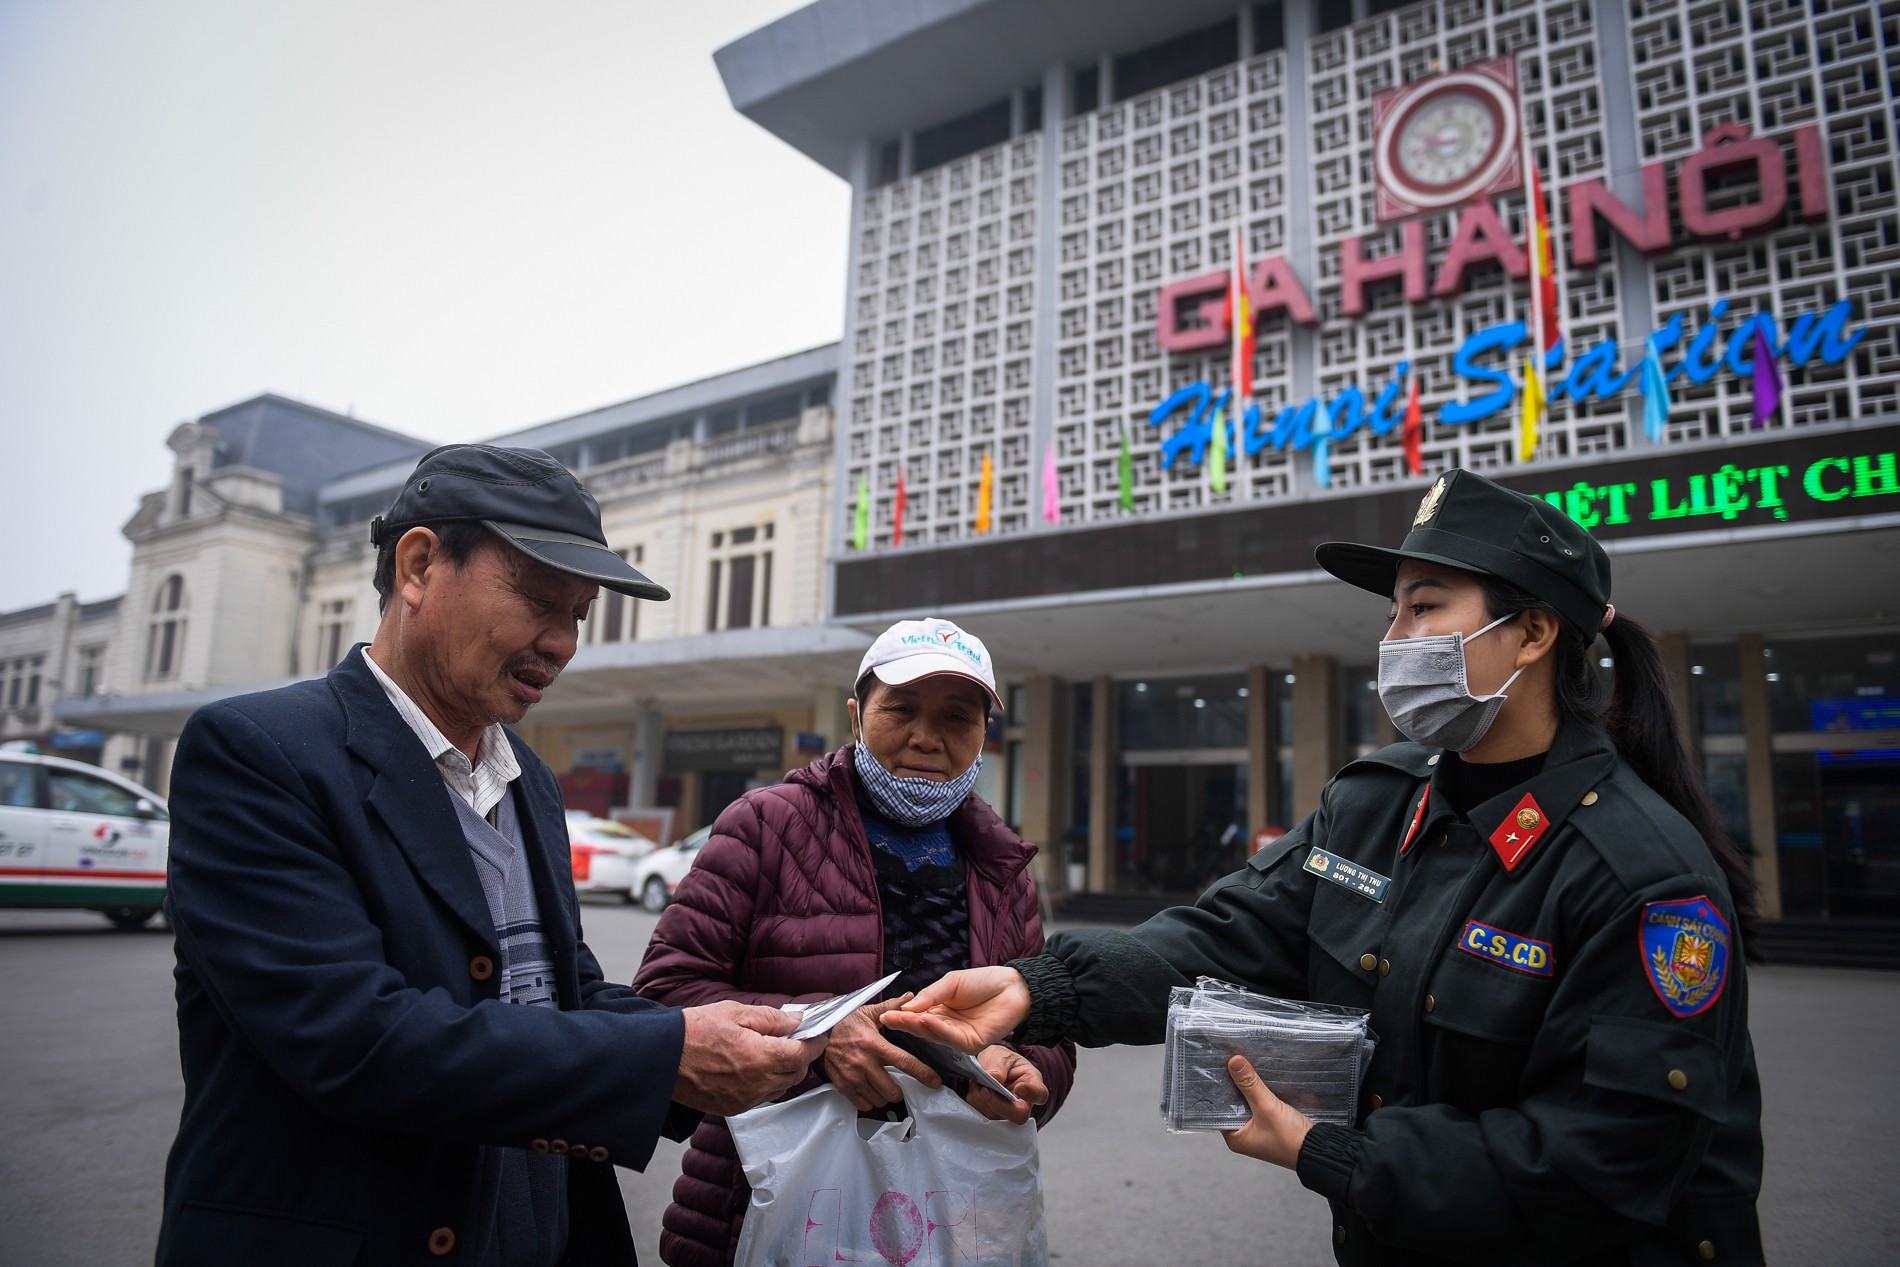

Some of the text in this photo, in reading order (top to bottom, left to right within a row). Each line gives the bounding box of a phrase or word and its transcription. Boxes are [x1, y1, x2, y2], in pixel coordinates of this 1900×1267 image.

[1157, 256, 1319, 352] GA
[1568, 121, 1828, 268] NỘI
[1333, 872, 1349, 883] 801
[1358, 884, 1376, 894] 260
[1369, 877, 1382, 887] THU
